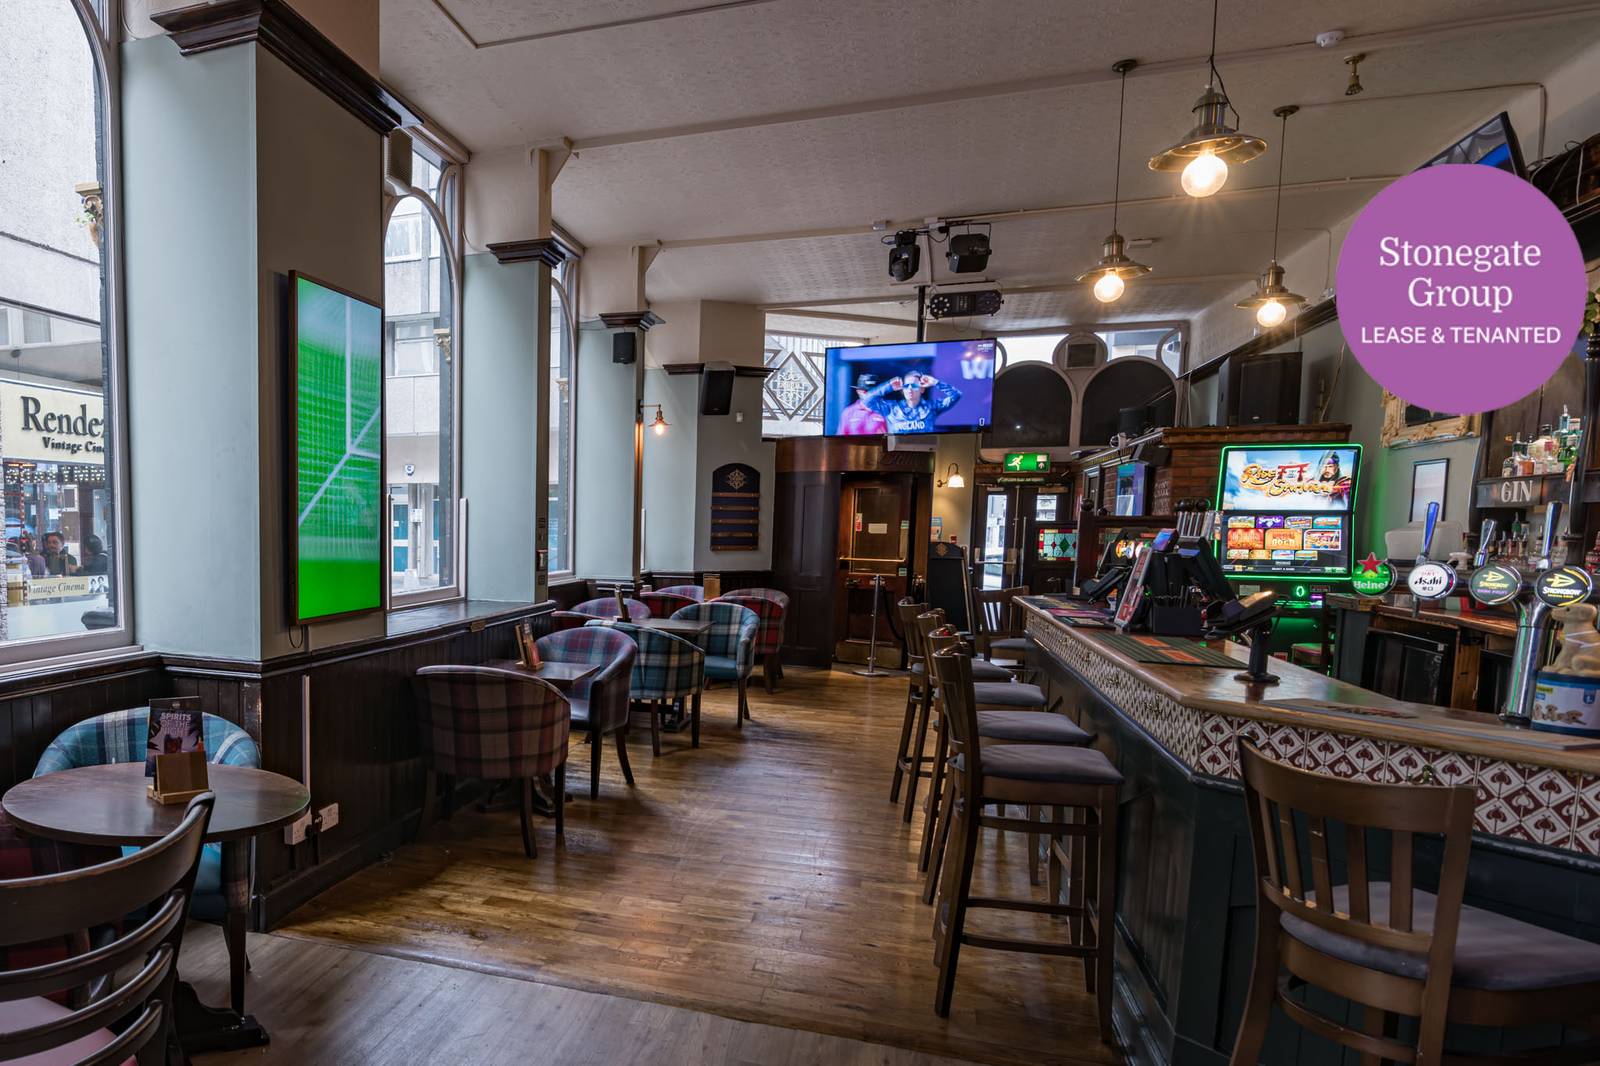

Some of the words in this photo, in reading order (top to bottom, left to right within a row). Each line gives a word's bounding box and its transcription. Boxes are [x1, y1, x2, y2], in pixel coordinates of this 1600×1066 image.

[42, 436, 83, 454] Vintage
[1501, 480, 1533, 503] GIN
[1414, 576, 1443, 586] Asahi
[58, 582, 85, 592] Cinema
[160, 712, 192, 721] SPIRITS
